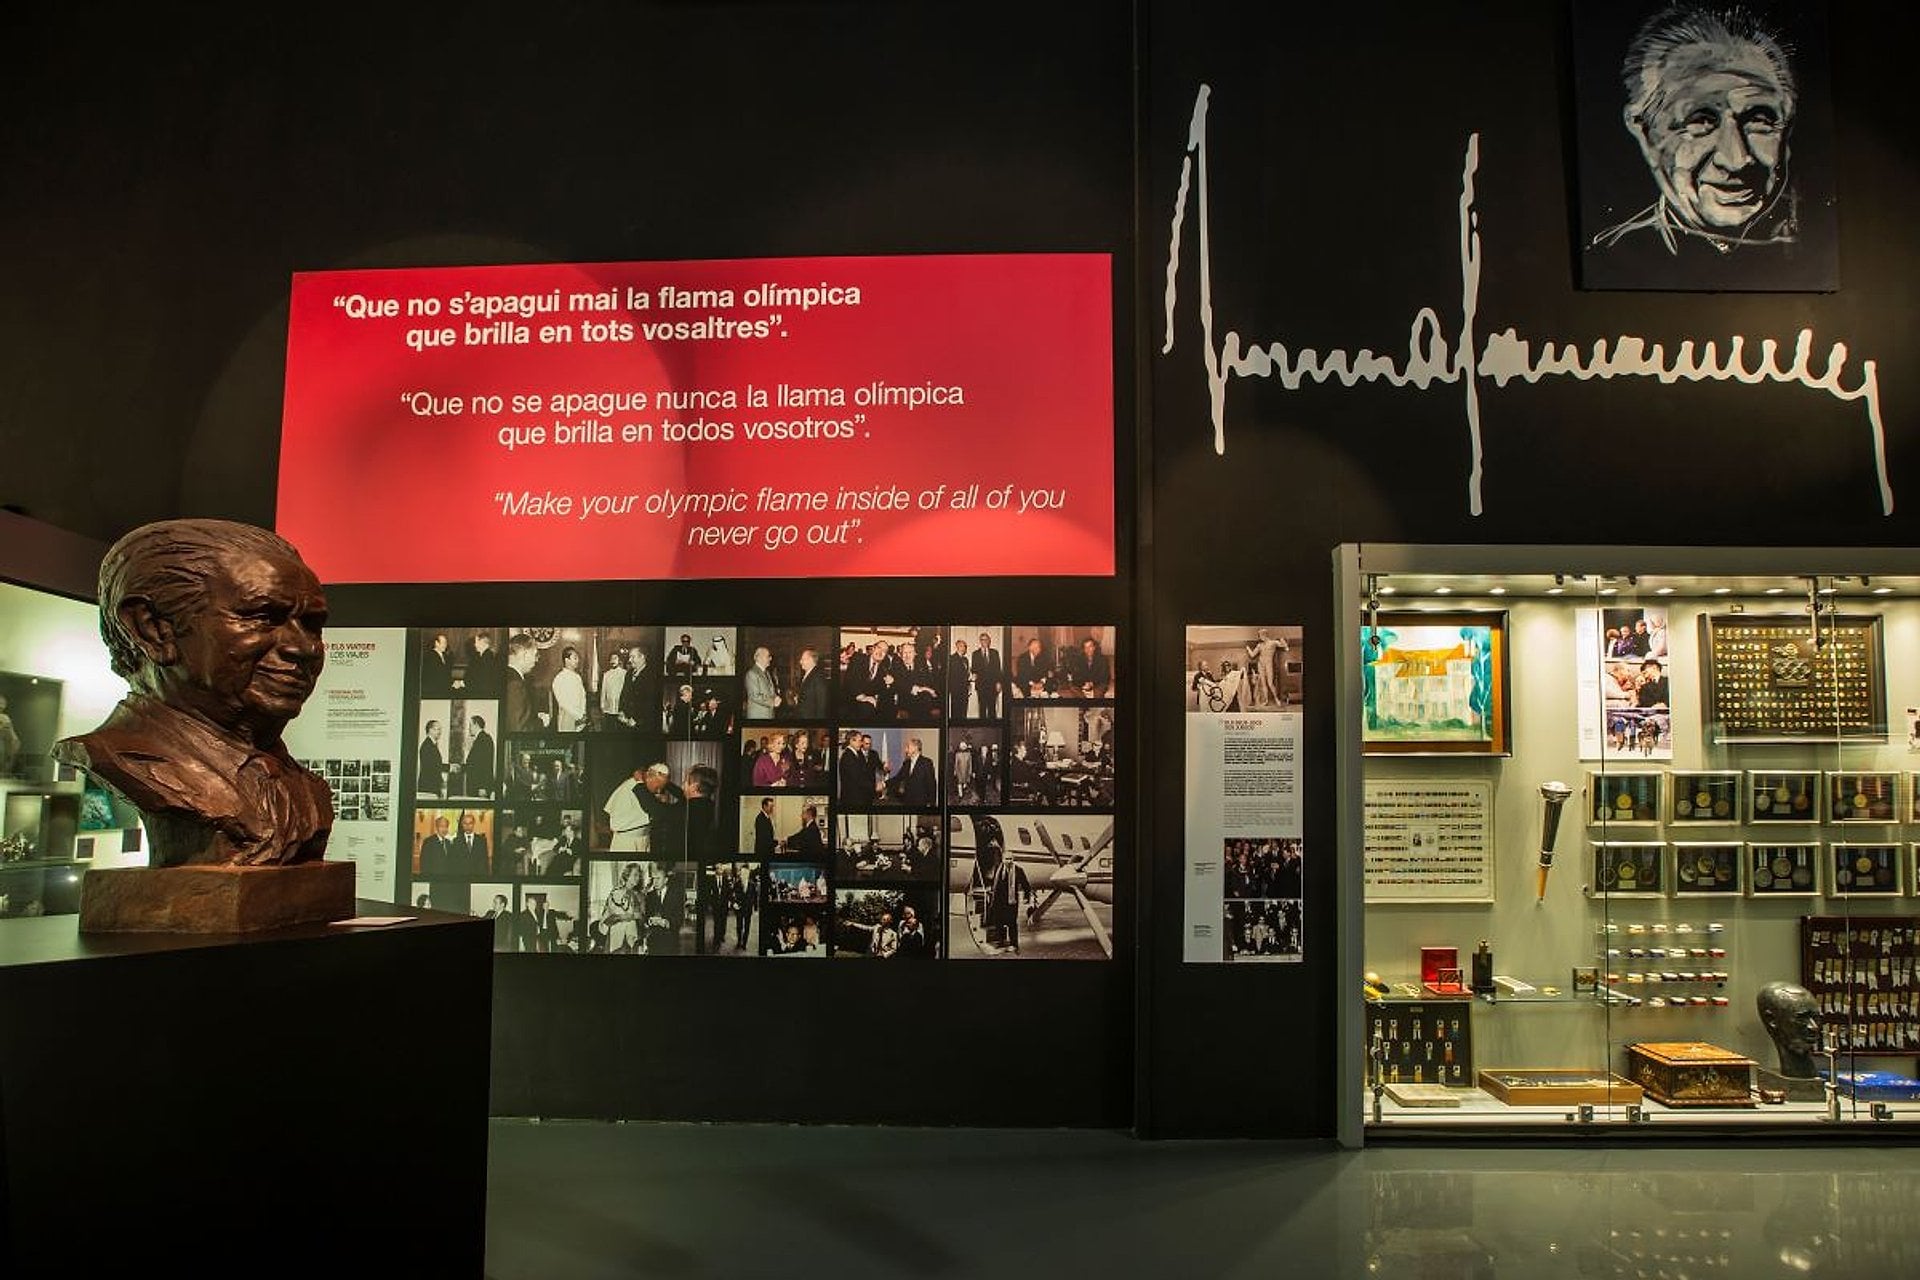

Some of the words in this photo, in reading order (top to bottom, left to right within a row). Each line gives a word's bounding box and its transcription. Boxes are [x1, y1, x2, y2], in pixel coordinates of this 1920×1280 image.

[332, 294, 400, 320] “Que
[407, 297, 442, 317] no
[448, 288, 561, 320] s’apagui
[568, 287, 619, 312] mai
[626, 286, 650, 311] la
[657, 285, 735, 309] flama
[743, 281, 861, 312] olímpica
[405, 327, 458, 353] que
[463, 320, 530, 346] brilla
[538, 324, 573, 344] en
[580, 319, 635, 343] tots
[641, 313, 789, 341] vosaltres”.
[400, 391, 464, 417] “Que
[471, 394, 504, 415] no
[511, 394, 543, 414] se
[549, 391, 648, 418] apague
[655, 390, 738, 410] nunca
[746, 383, 769, 408] la
[777, 383, 846, 408] llama
[854, 380, 965, 411] olímpica
[497, 426, 547, 451] que
[554, 419, 614, 445] brilla
[621, 423, 653, 443] en
[660, 417, 735, 442] todos
[742, 413, 870, 440] vosotros”.
[494, 490, 573, 516] “Make
[578, 494, 640, 521] your
[644, 487, 749, 519] olympic
[756, 486, 829, 512] flame
[835, 484, 910, 511] inside
[918, 484, 947, 510] of
[950, 483, 980, 510] all
[986, 483, 1014, 509] of
[1017, 489, 1066, 514] you
[687, 525, 760, 546] never
[764, 524, 799, 551] go
[806, 518, 863, 545] out”.
